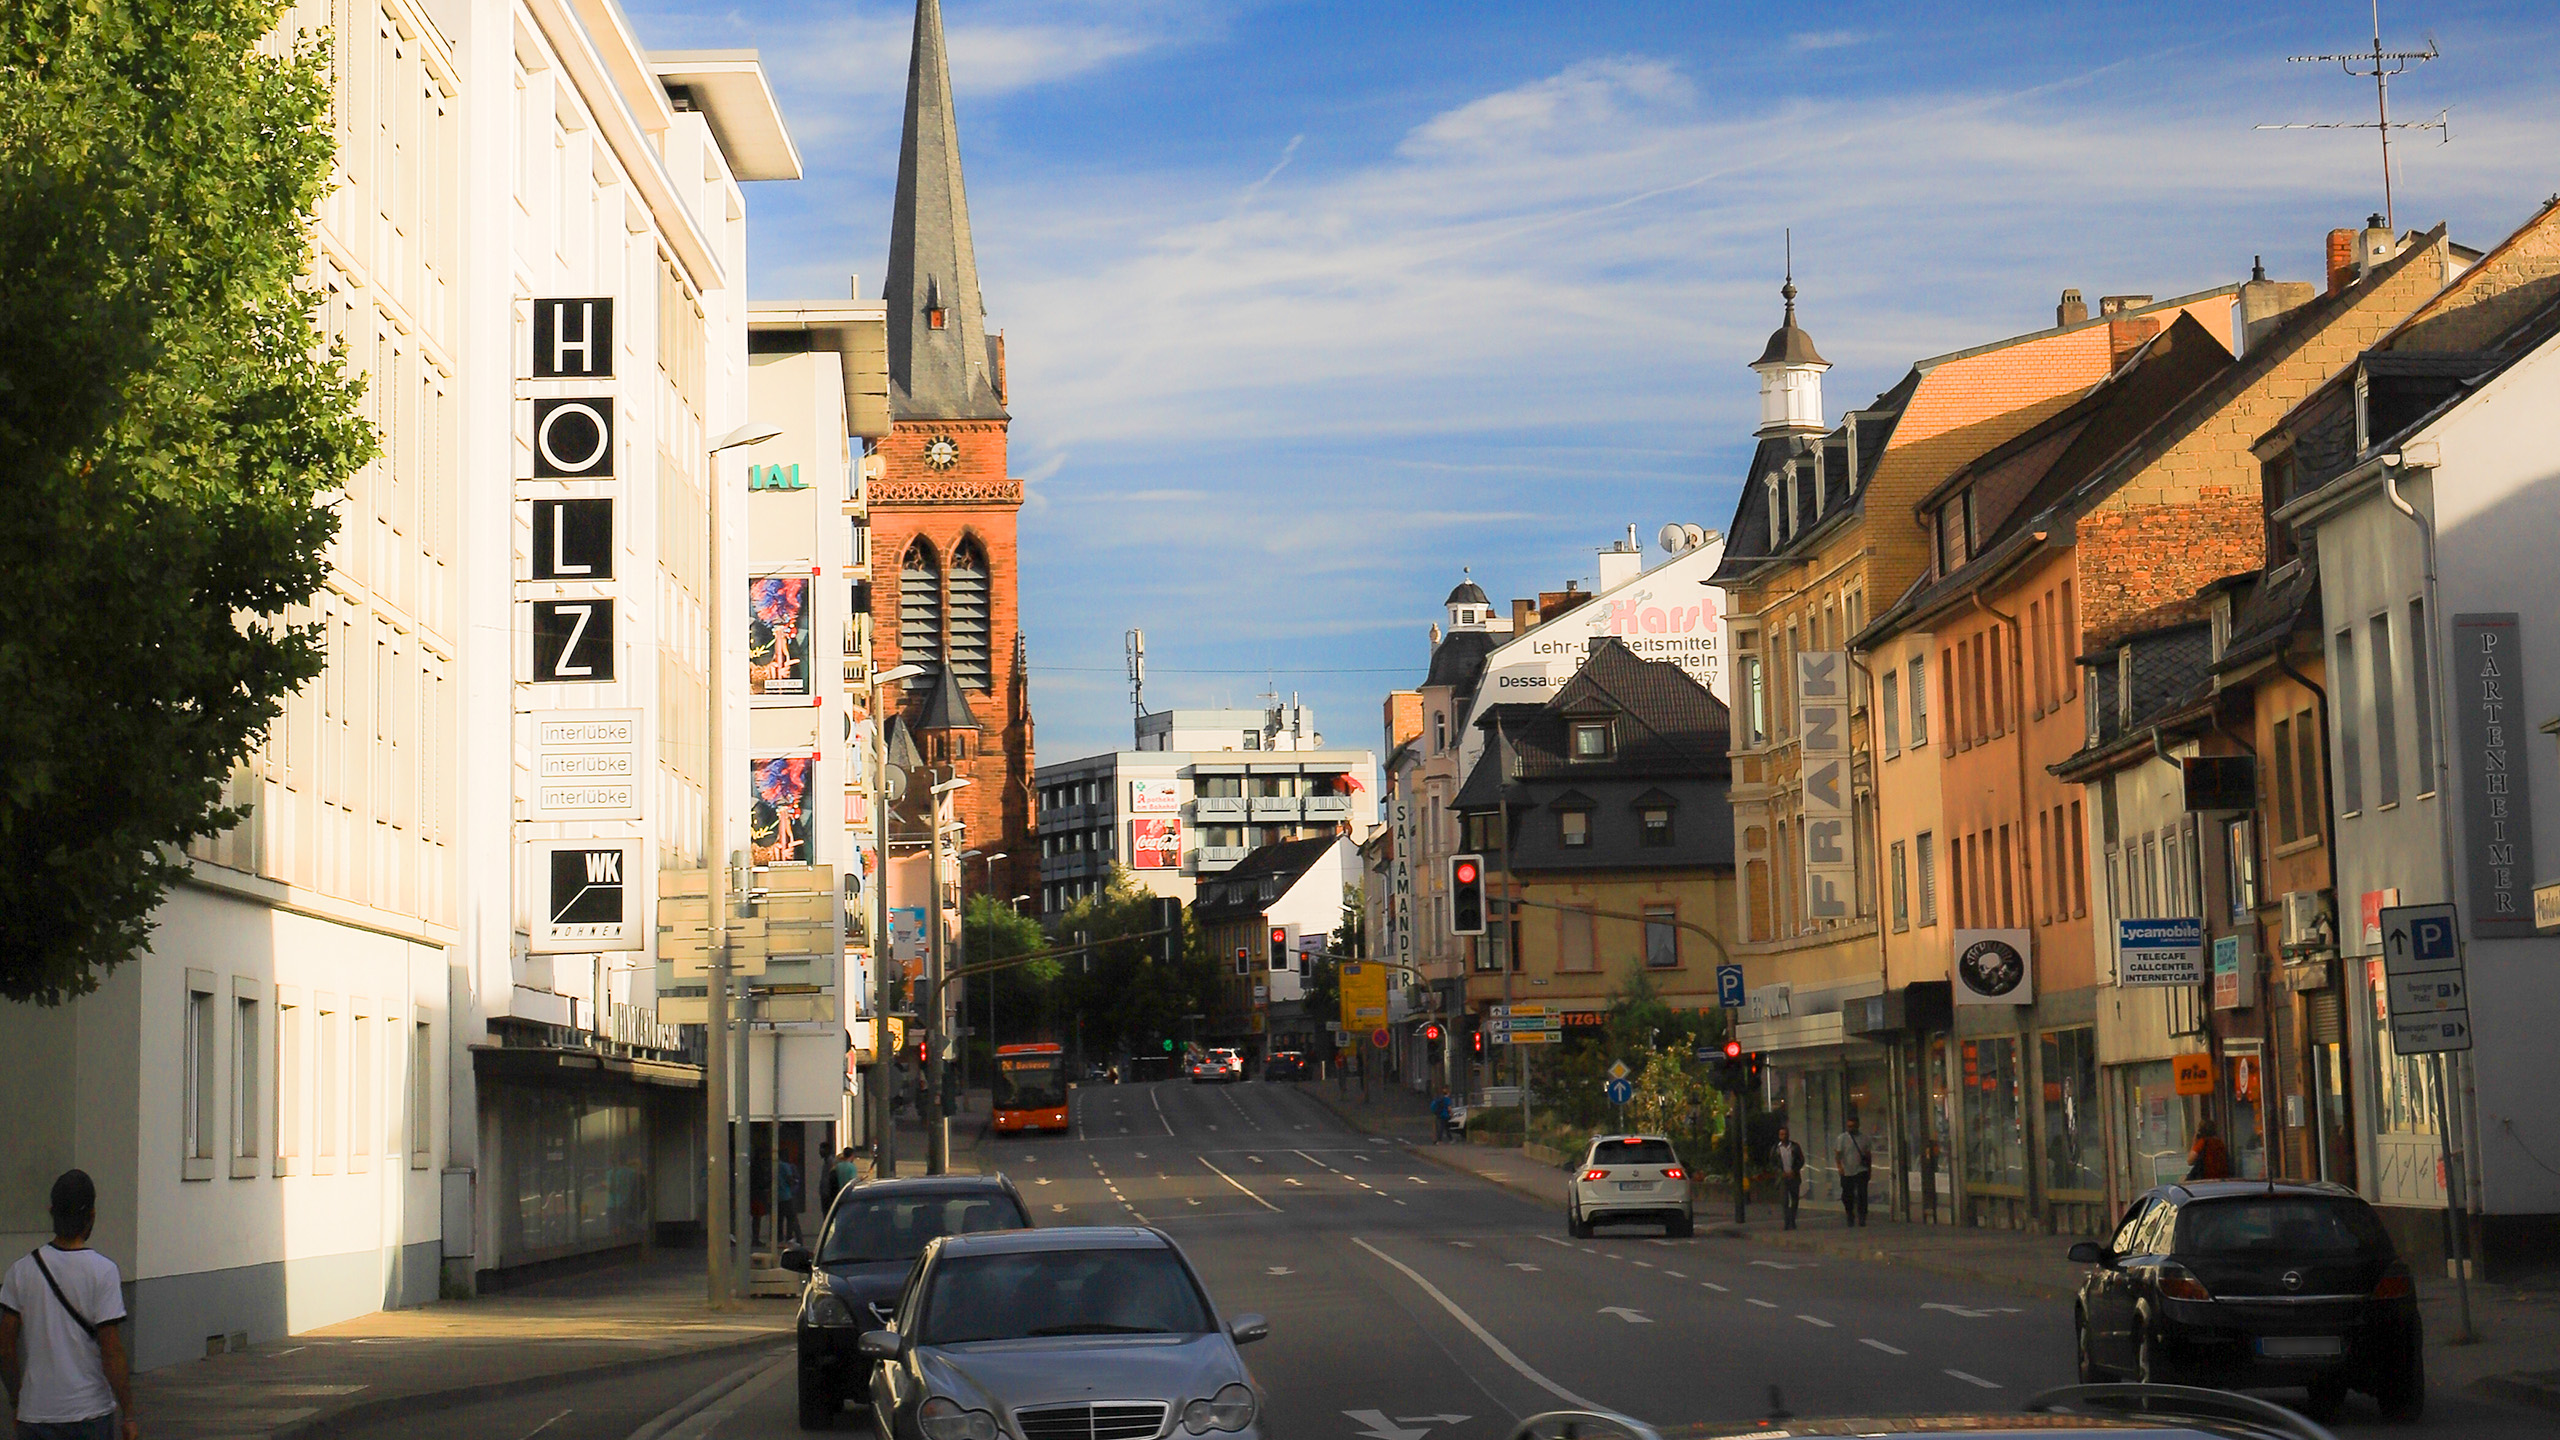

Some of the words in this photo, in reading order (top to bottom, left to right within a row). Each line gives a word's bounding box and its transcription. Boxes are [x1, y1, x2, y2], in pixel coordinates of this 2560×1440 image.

[538, 303, 610, 676] HOLZ
[1610, 598, 1718, 635] Karst
[545, 725, 628, 741] interlübke
[545, 757, 628, 773] interlübke
[2480, 632, 2516, 914] PARTENHEIMER
[1803, 653, 1847, 917] FRANK
[545, 789, 628, 805] interlübke
[585, 852, 621, 883] WK
[1396, 805, 1410, 988] SALAMANDER
[551, 925, 622, 937] WOHNEN
[2121, 925, 2201, 940] Lycamobile
[2136, 952, 2187, 961] TELECAFE
[2130, 963, 2195, 972] CALLCENTER
[2126, 973, 2200, 982] INTERNETCAFE
[2181, 1062, 2208, 1080] Ria
